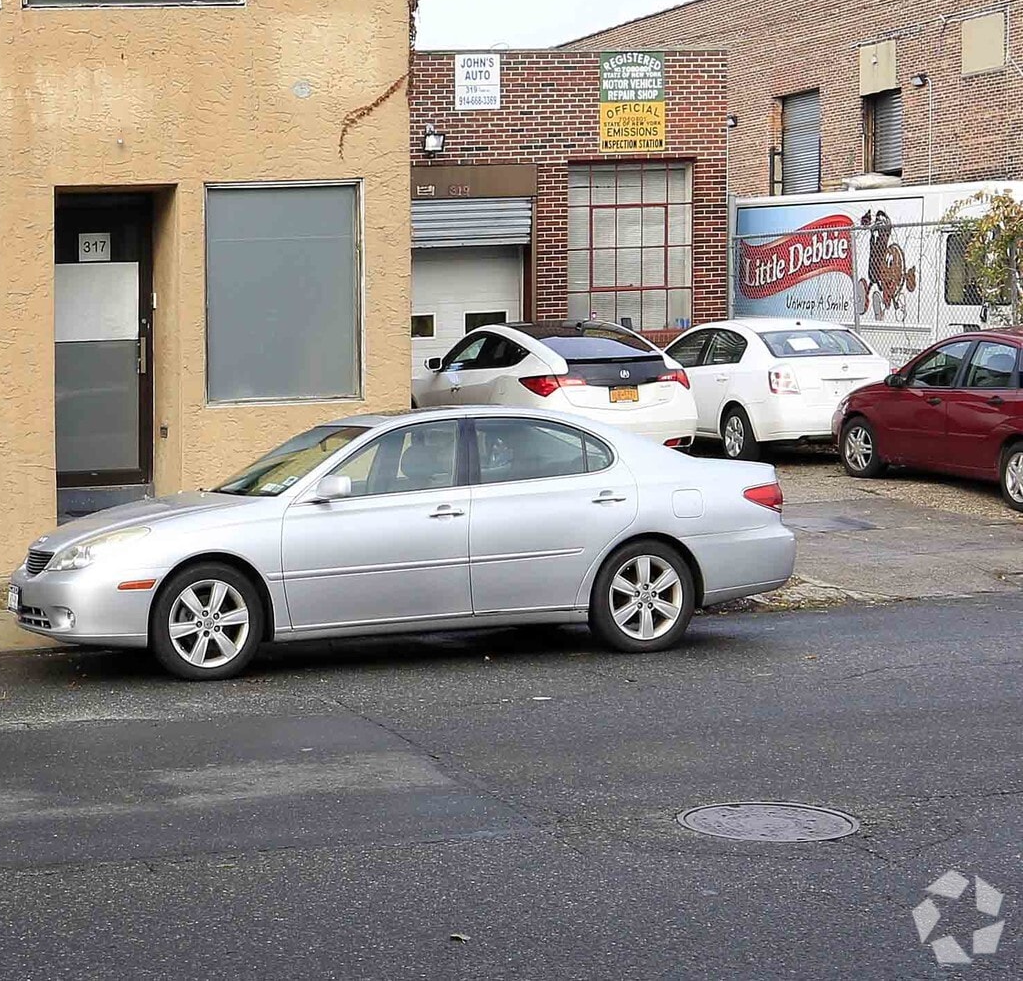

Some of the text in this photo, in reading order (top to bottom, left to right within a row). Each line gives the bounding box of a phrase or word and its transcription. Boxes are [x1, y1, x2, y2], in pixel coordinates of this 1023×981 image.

[460, 57, 495, 68] JOHN'S
[603, 52, 662, 71] REGISTERED
[465, 70, 491, 81] AUTO
[602, 78, 663, 90] MOTOR VEHICLE
[607, 89, 659, 101] REPAIR SHOP
[606, 103, 660, 119] OFFICIAL
[607, 127, 658, 137] EMISSIONS
[602, 139, 663, 150] INSPECTION STATION
[83, 241, 107, 253] 317
[744, 230, 848, 287] Little Debbie
[786, 295, 849, 315] Unwrap A Smile
